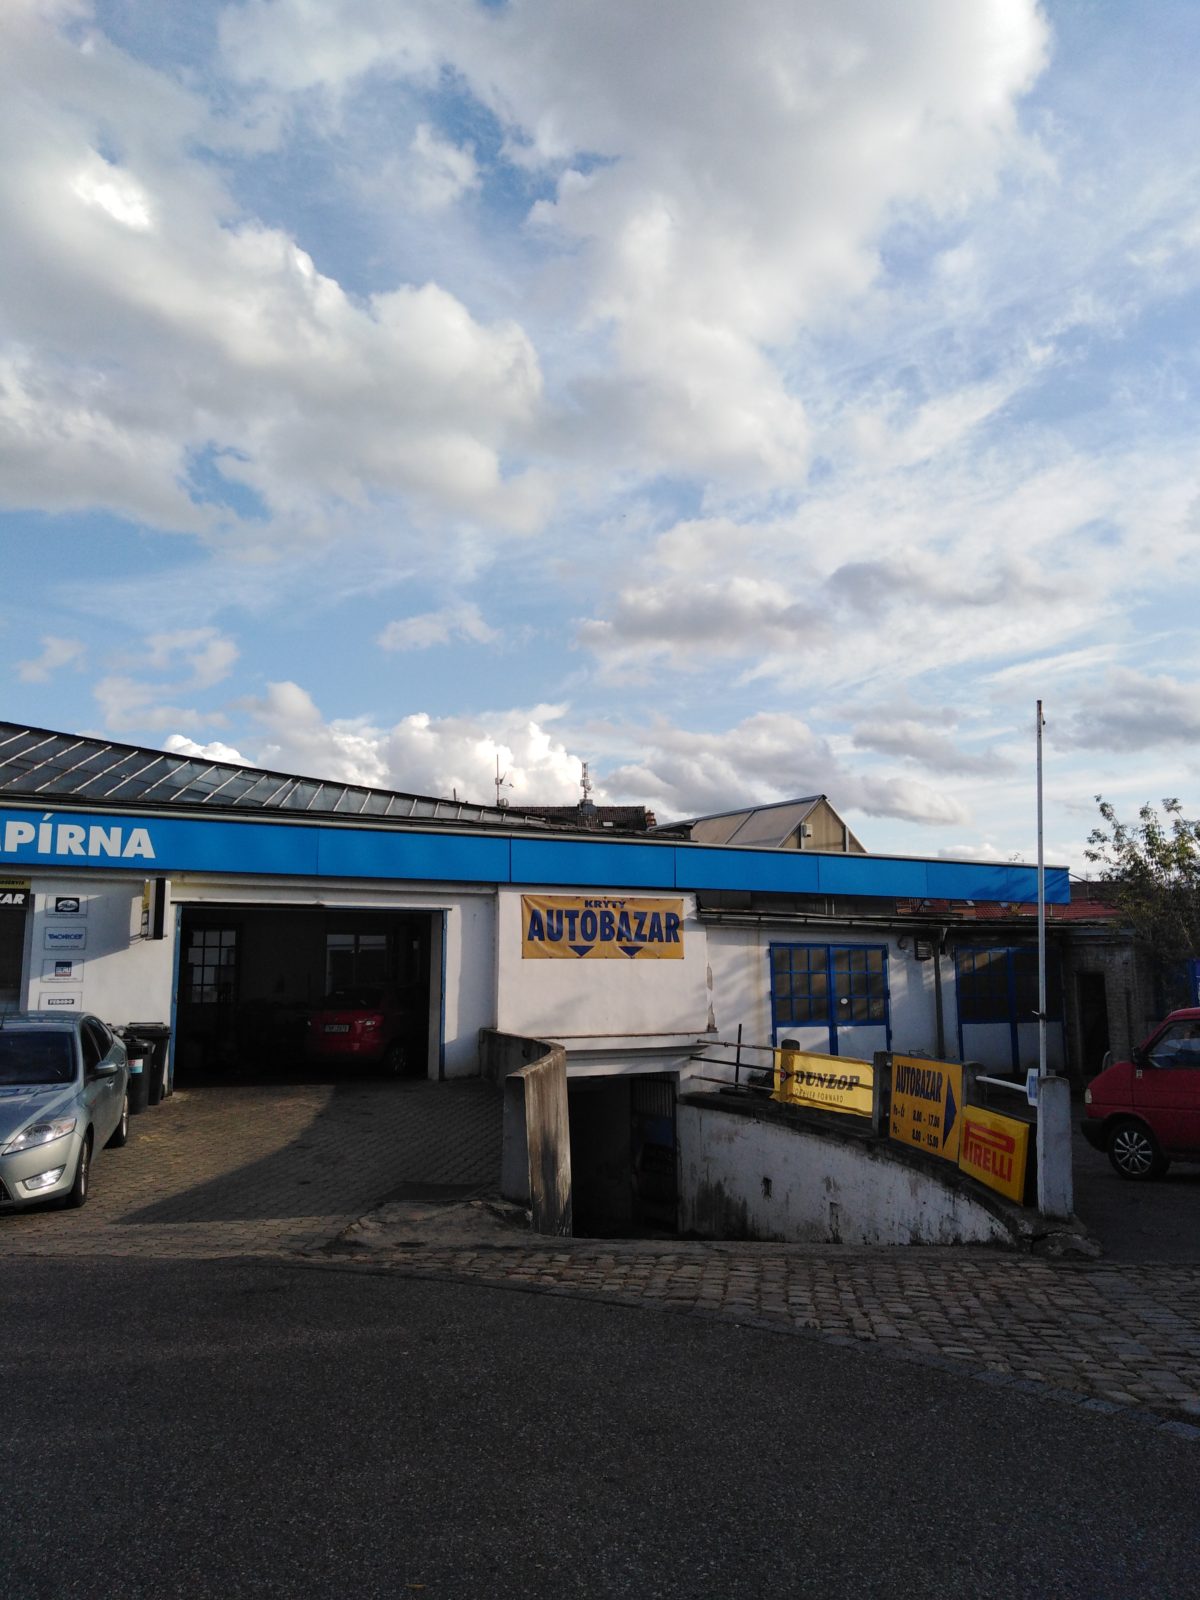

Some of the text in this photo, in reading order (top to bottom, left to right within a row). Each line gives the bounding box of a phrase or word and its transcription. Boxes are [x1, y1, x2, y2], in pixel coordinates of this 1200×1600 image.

[0, 813, 156, 859] PÍRNA
[527, 909, 680, 943] AUTOBAZAR
[795, 1070, 860, 1091] DUNLOP
[896, 1065, 943, 1103] AUTOBAZAR
[963, 1120, 1016, 1183] PIRELLI
